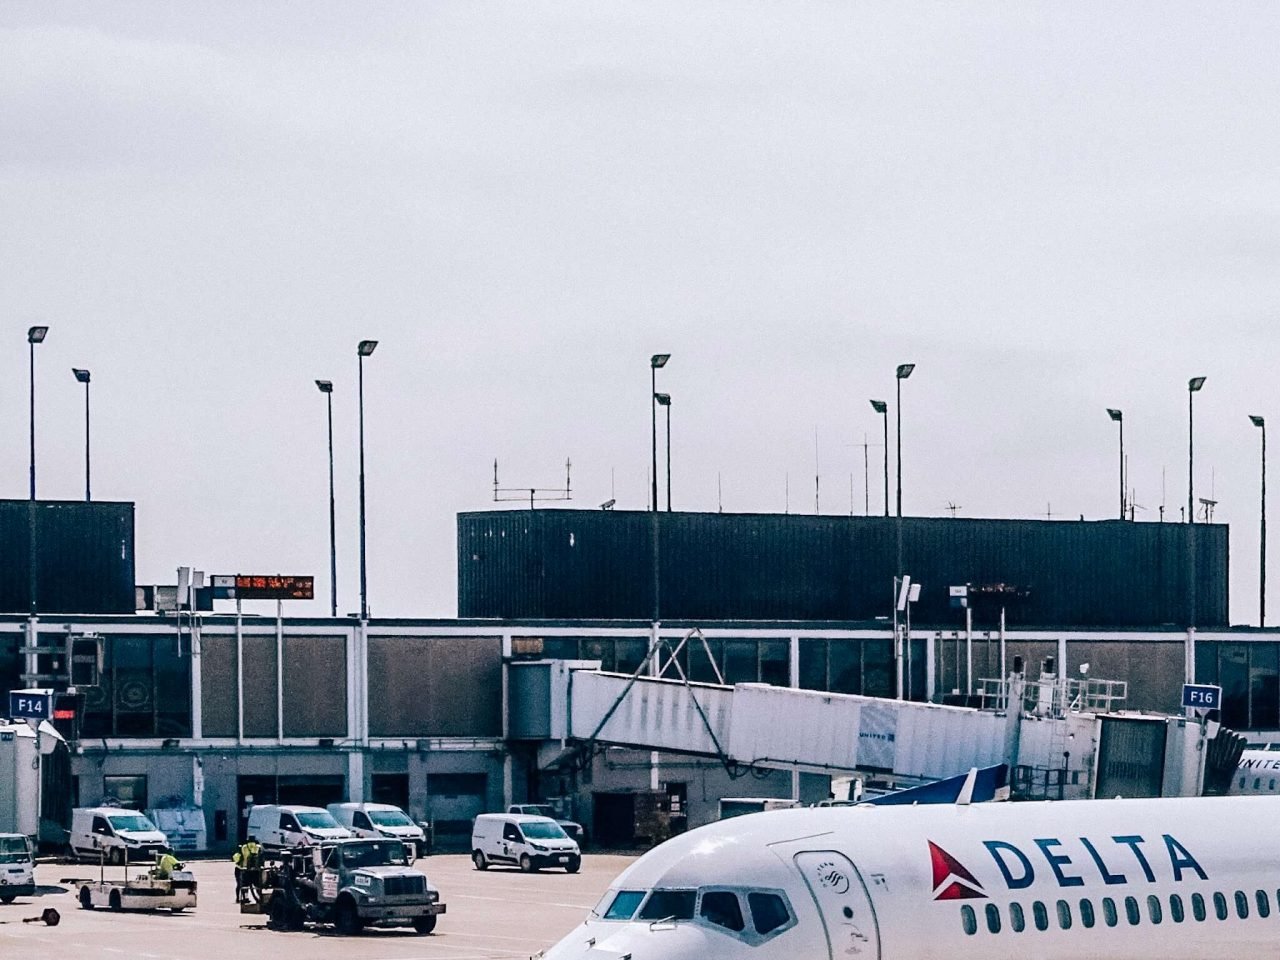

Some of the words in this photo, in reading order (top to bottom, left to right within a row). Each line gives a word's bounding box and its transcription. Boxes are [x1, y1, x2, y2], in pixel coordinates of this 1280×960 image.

[1190, 691, 1213, 703] F16
[18, 699, 42, 712] F14
[982, 834, 1209, 889] DELTA
